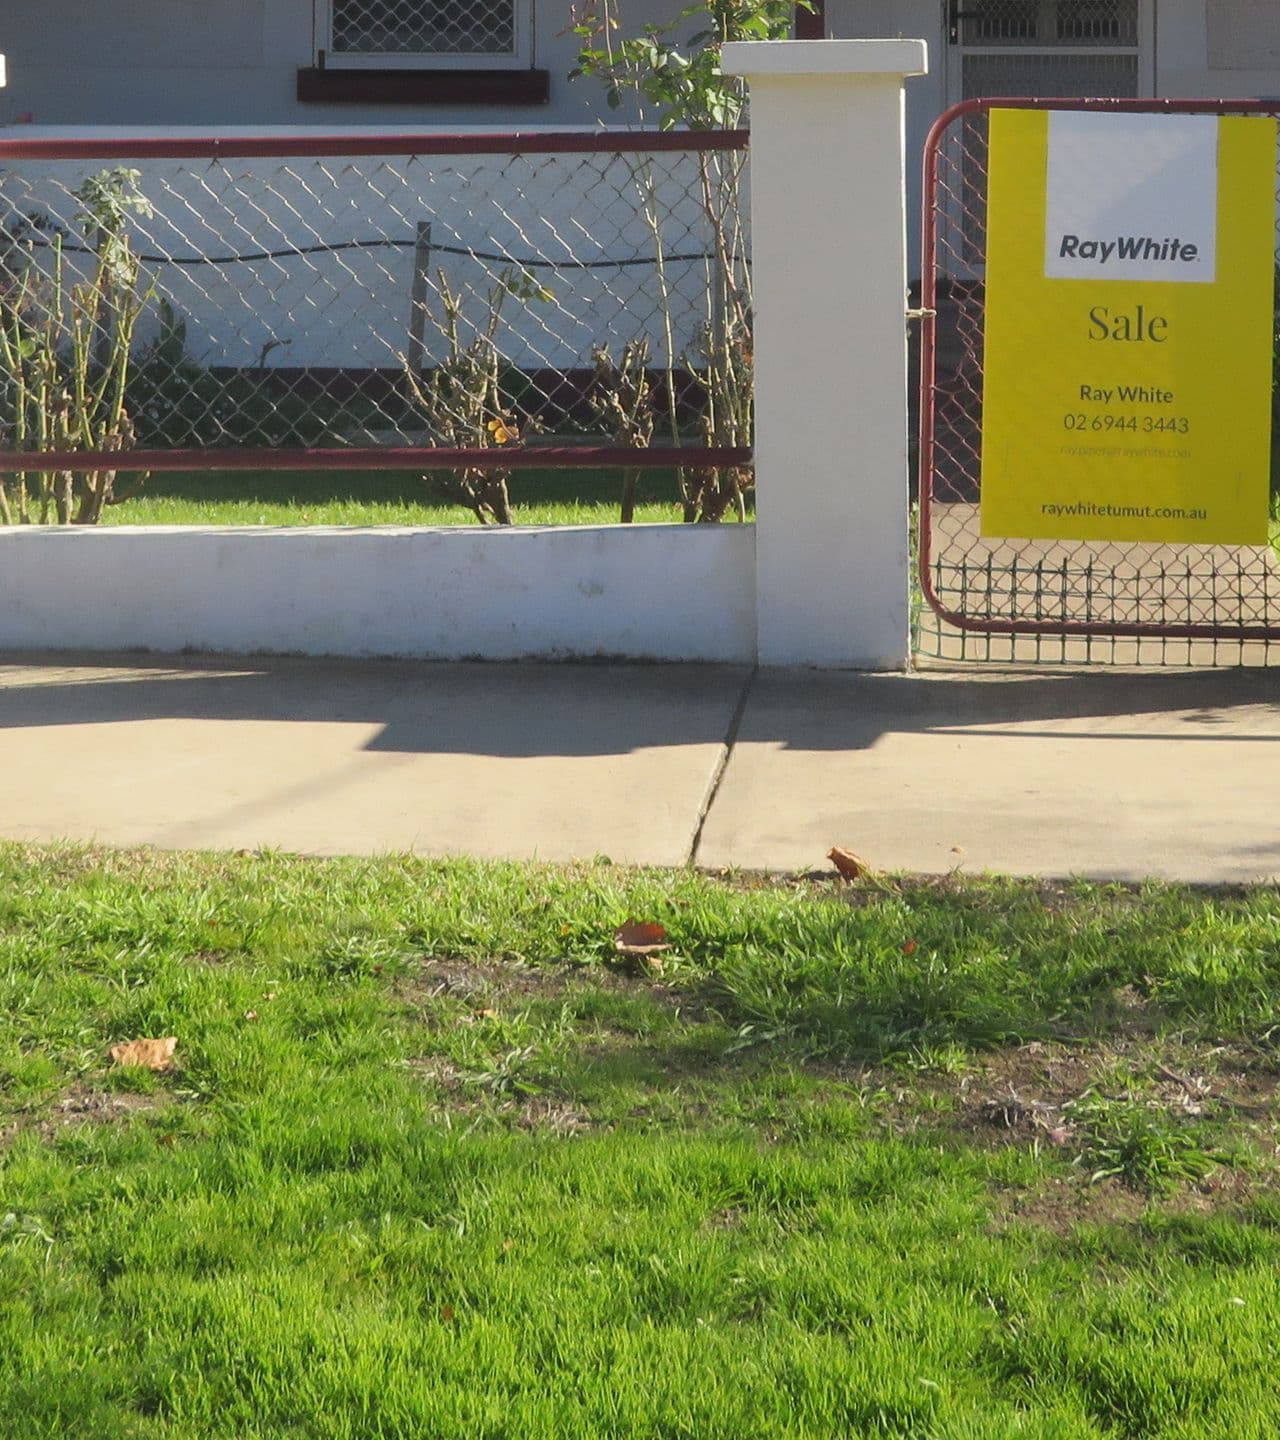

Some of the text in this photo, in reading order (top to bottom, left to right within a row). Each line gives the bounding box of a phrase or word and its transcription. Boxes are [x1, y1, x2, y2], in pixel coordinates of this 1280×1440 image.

[1088, 305, 1168, 343] Sale
[1080, 385, 1174, 404] Ray White
[1064, 414, 1190, 434] 02 6944 3443
[1041, 502, 1207, 520] raywhitetumut.com.au
